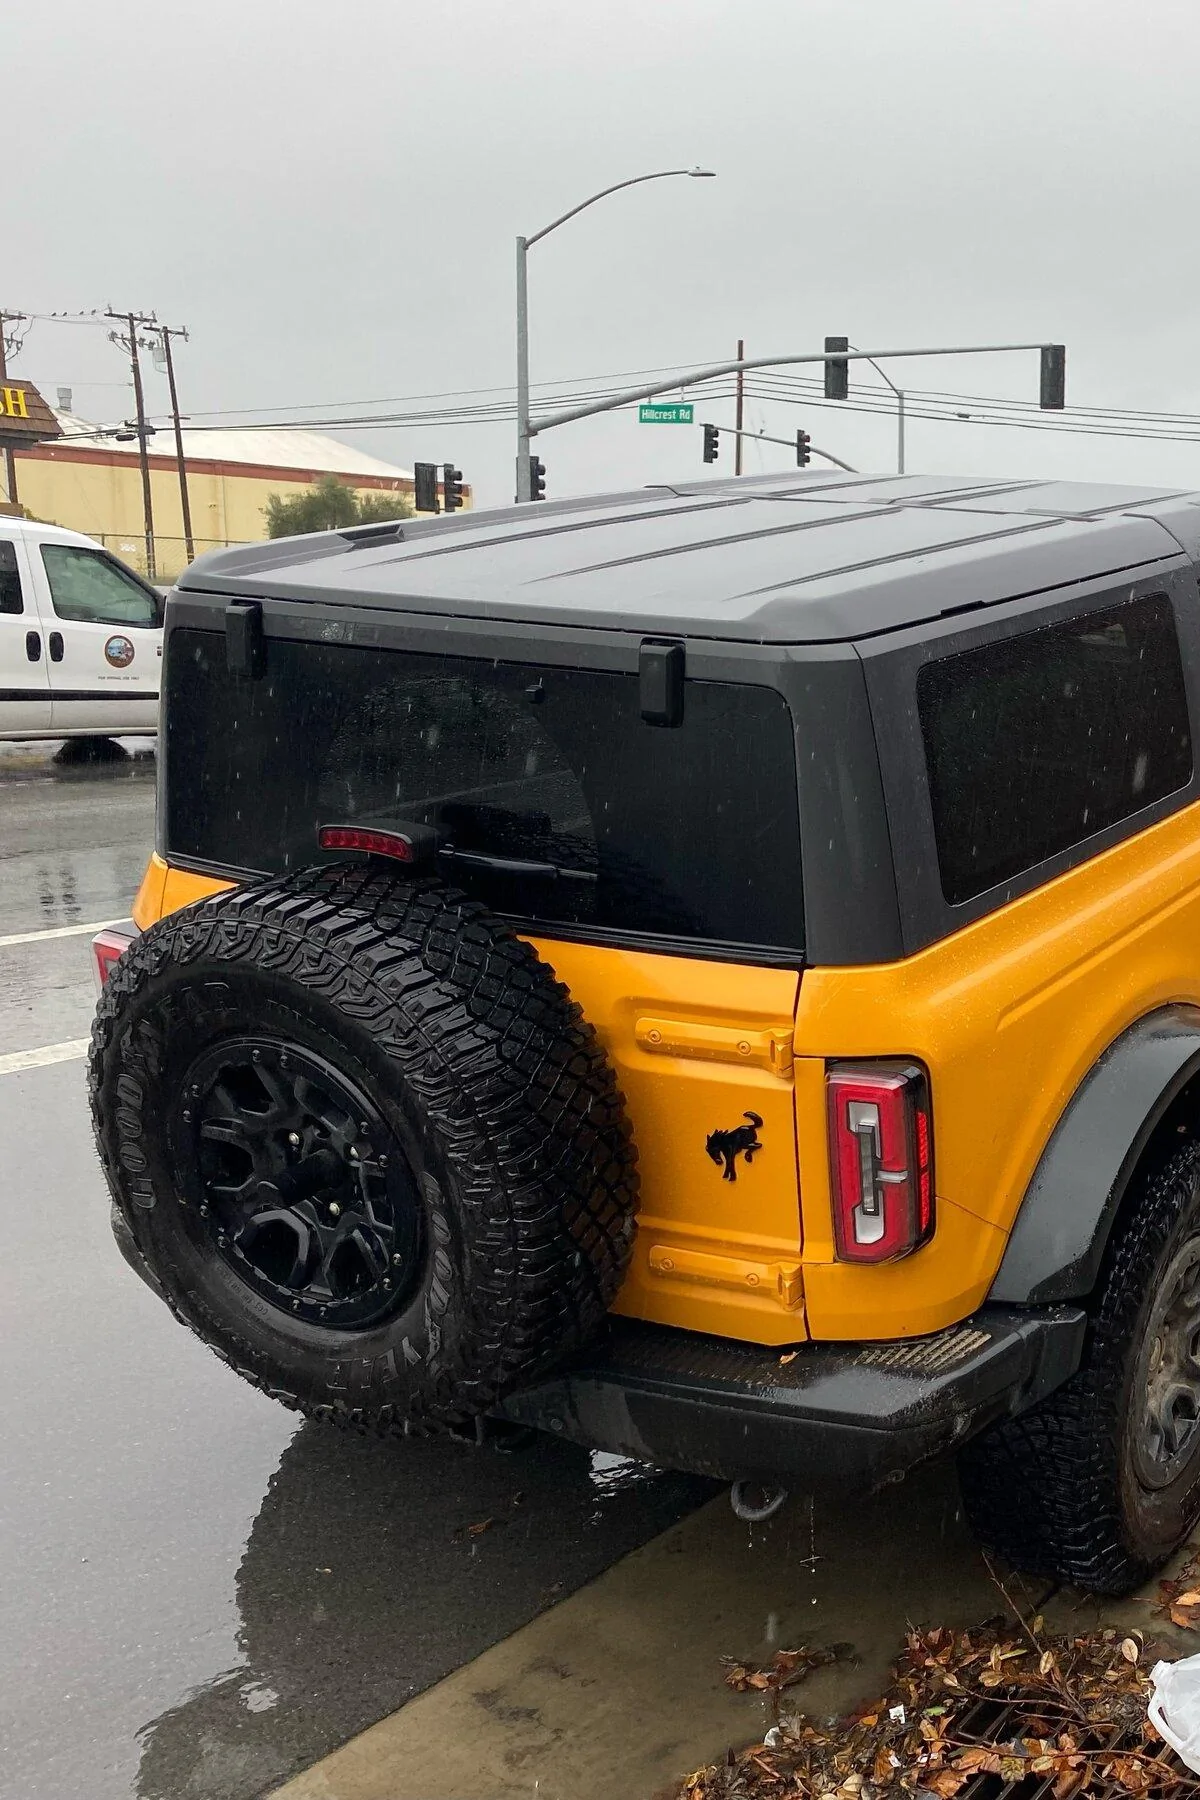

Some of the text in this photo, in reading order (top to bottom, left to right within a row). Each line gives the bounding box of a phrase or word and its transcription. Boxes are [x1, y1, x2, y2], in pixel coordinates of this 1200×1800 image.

[0, 387, 31, 418] H
[641, 409, 691, 420] Hillcrest Rd
